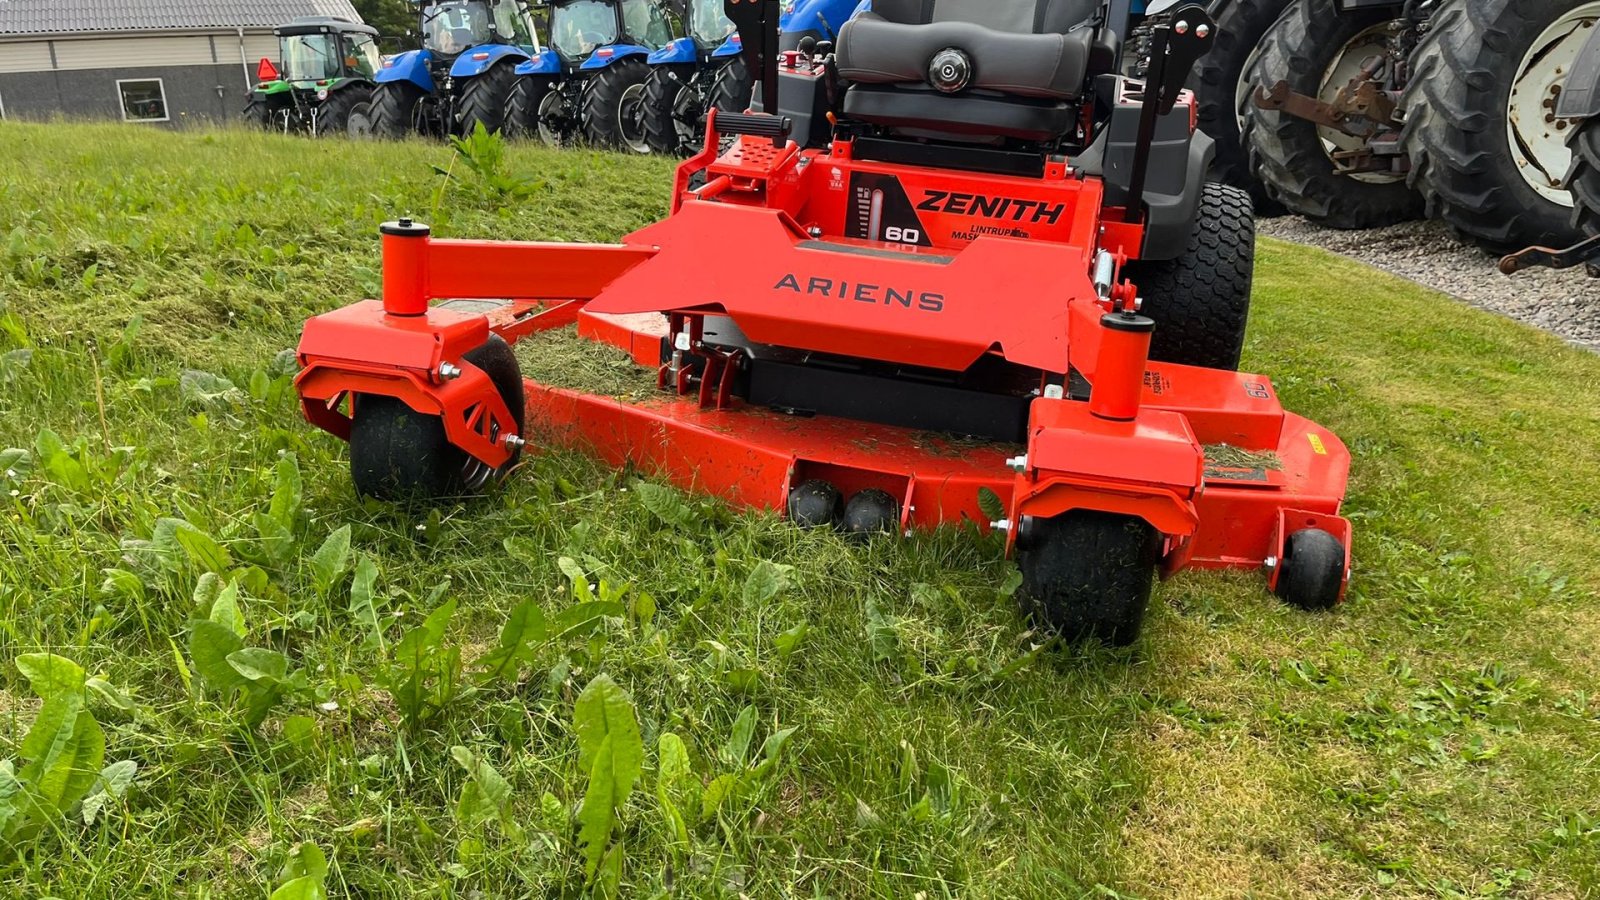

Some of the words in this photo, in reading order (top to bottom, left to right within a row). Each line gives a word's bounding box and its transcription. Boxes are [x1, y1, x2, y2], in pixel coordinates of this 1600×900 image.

[916, 189, 1065, 225] ZENITH
[885, 226, 919, 243] 60
[970, 225, 1011, 237] LINTRUP
[773, 273, 945, 312] ARIENS
[1244, 382, 1269, 399] 60
